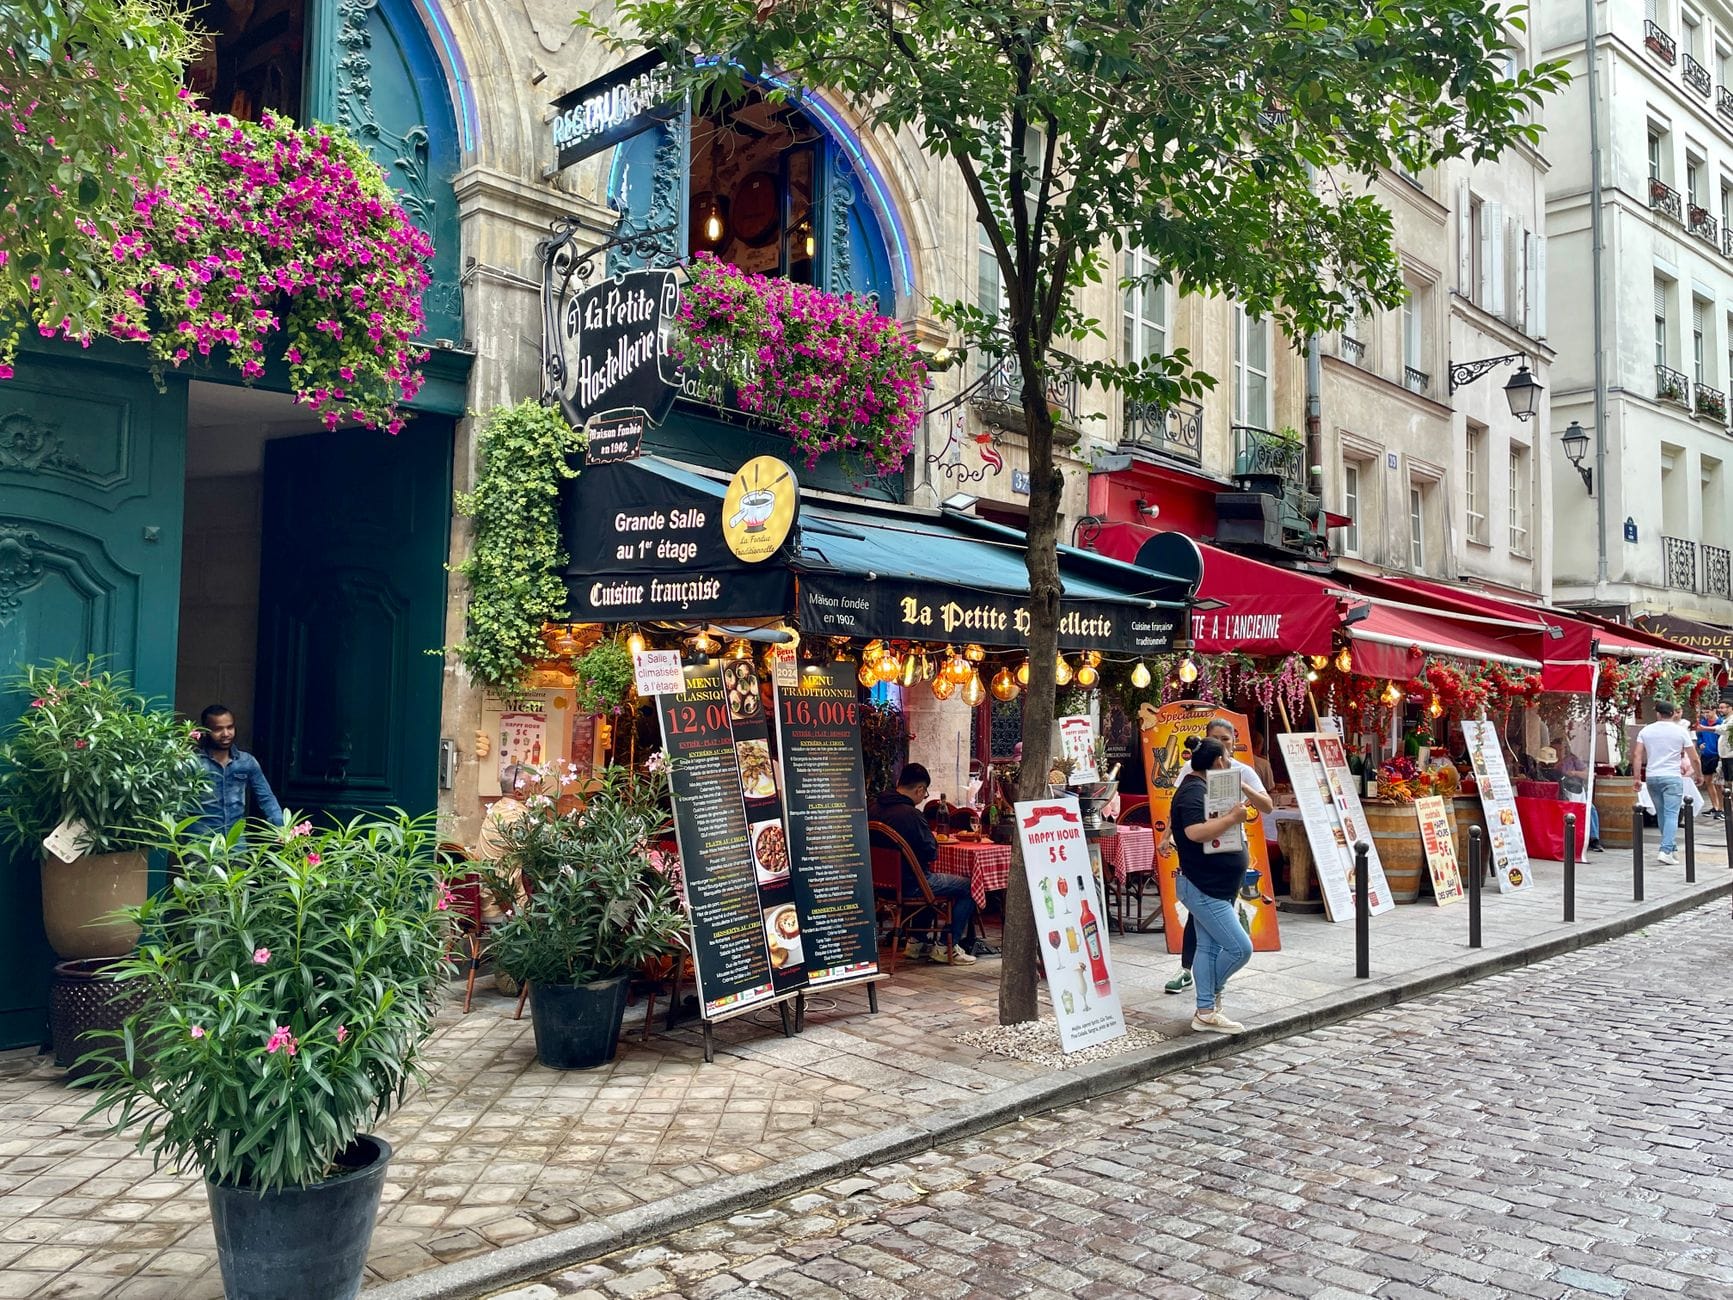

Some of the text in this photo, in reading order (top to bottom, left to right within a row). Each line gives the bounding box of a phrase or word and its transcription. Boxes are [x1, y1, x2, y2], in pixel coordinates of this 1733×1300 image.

[584, 287, 655, 331] La Petite
[579, 329, 656, 409] Hostellerie
[590, 428, 616, 442] Maison
[610, 441, 628, 453] 1902
[615, 508, 706, 532] Grande Salle
[616, 539, 697, 563] au 1er étage
[590, 574, 720, 610] Cuisine française
[809, 592, 870, 610] Maison fondée
[824, 614, 856, 626] en 1902
[900, 596, 933, 626] La
[940, 601, 1007, 633] Petite
[1212, 615, 1218, 639] A
[1225, 614, 1282, 639] L'ANCIENNE
[647, 654, 668, 664] Salle
[638, 666, 679, 678] climatisée
[802, 675, 833, 686] MENU
[653, 680, 679, 693] l'étage
[686, 677, 720, 689] MENU
[781, 687, 855, 698] TRADITIONNEL
[784, 700, 857, 728] 16,00€
[1028, 828, 1080, 845] HAPPY HOUR
